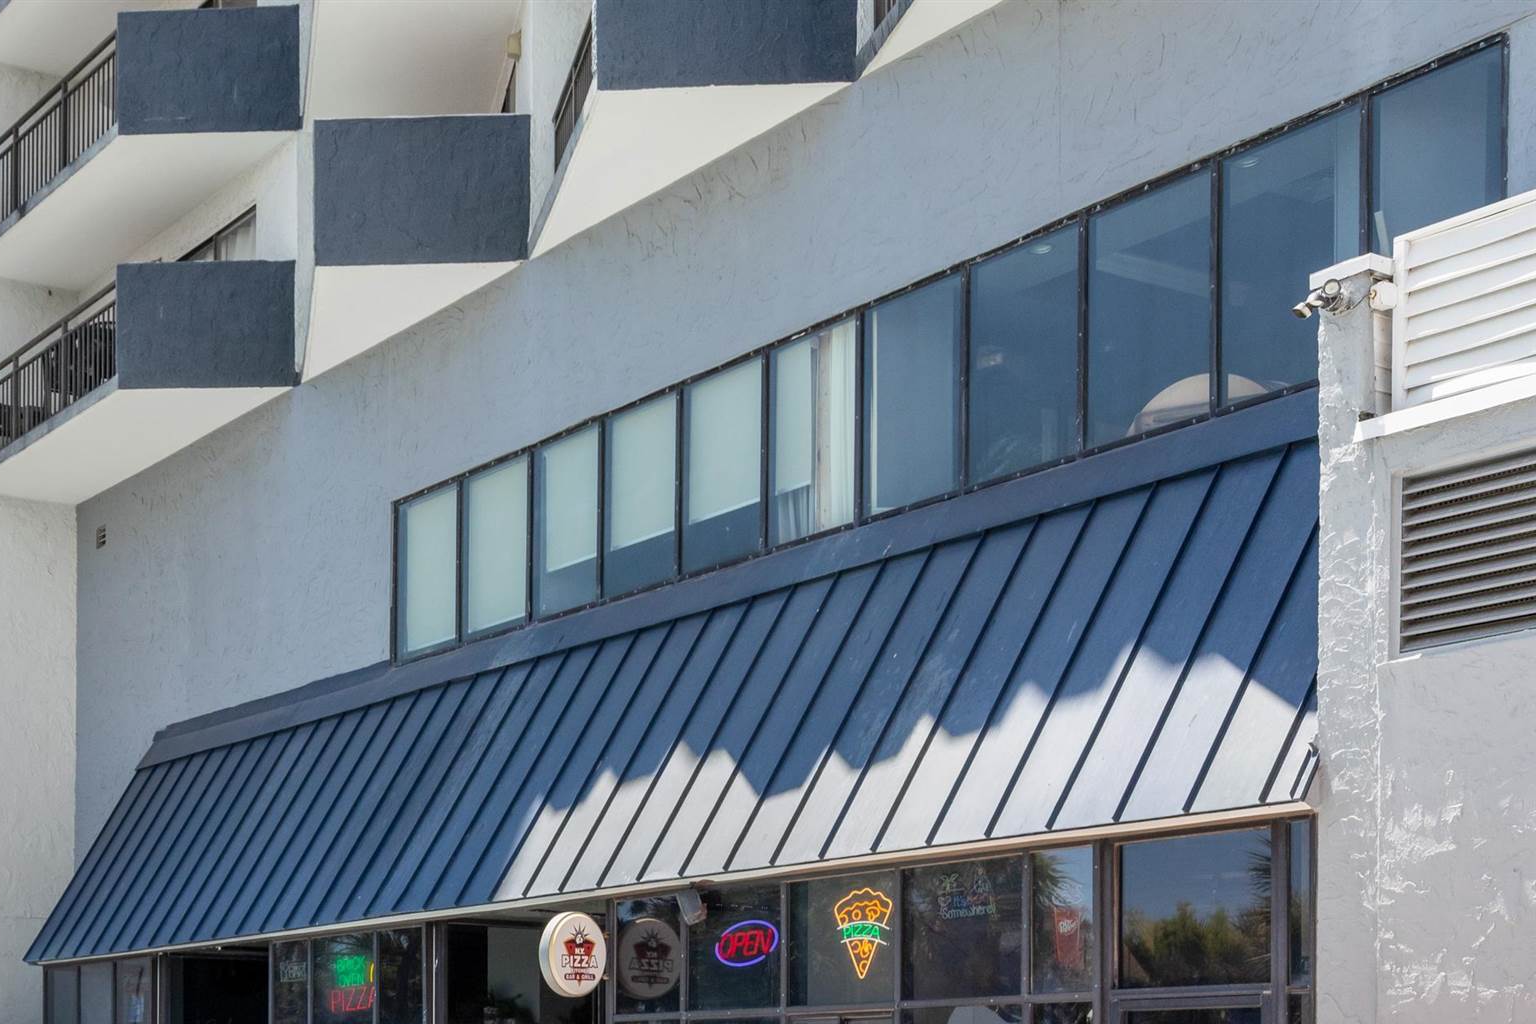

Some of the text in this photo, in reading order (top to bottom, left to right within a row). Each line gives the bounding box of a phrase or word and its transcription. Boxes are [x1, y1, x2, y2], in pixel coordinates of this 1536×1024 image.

[842, 923, 881, 939] PIZZA
[718, 927, 774, 960] OPEN
[337, 955, 366, 971] BRICK
[561, 954, 598, 968] PIZZA
[338, 973, 365, 987] OVEN
[330, 985, 376, 1013] PIZZA
